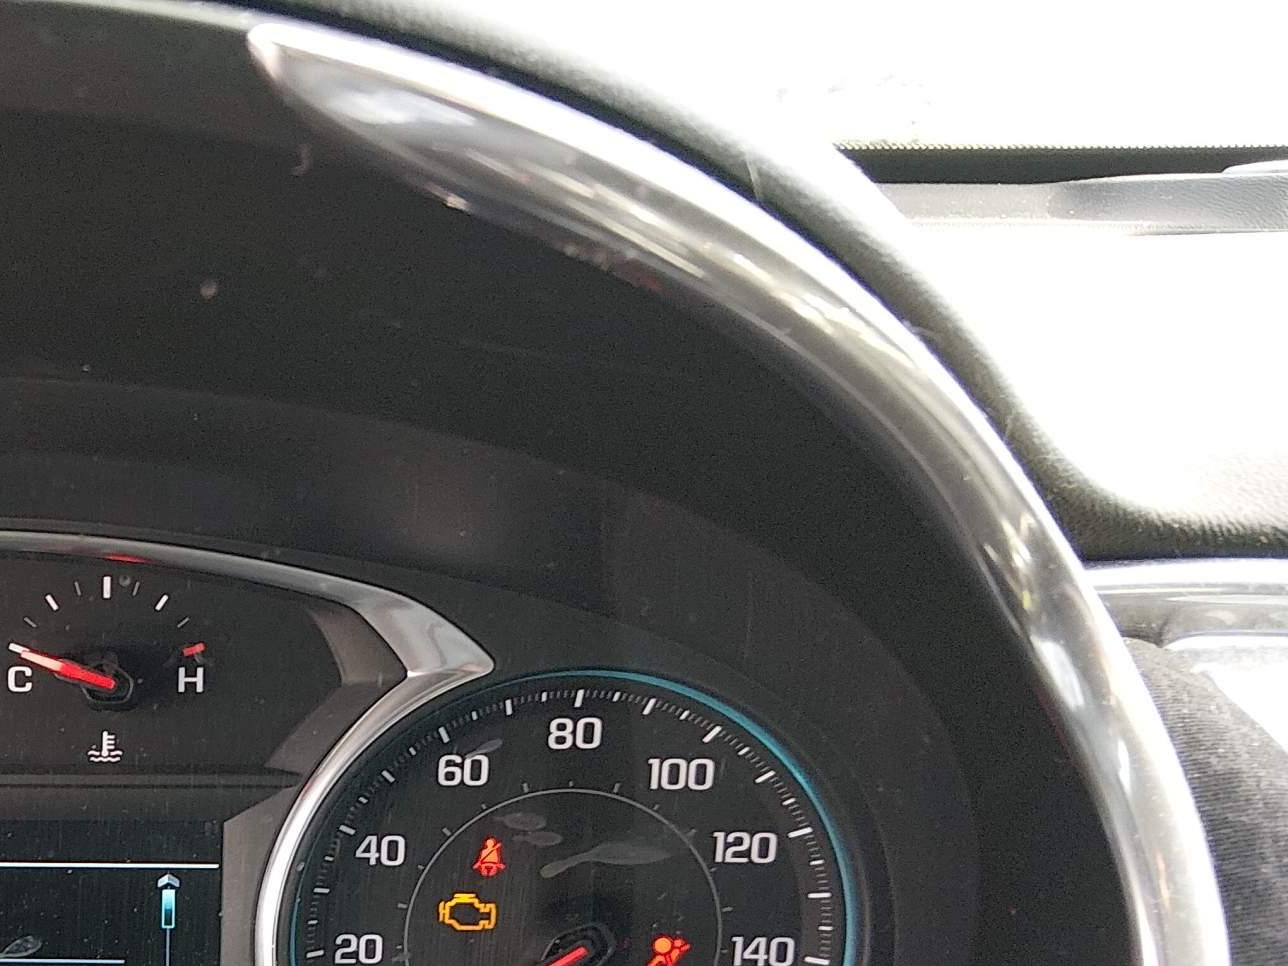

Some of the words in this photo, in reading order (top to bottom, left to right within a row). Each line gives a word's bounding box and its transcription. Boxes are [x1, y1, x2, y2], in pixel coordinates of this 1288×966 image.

[7, 666, 33, 693] C
[178, 667, 204, 693] H
[548, 717, 602, 750] 80
[438, 754, 489, 786] 60
[648, 758, 715, 791] 100
[355, 835, 406, 866] 40
[713, 831, 778, 864] 120
[334, 934, 383, 964] 20
